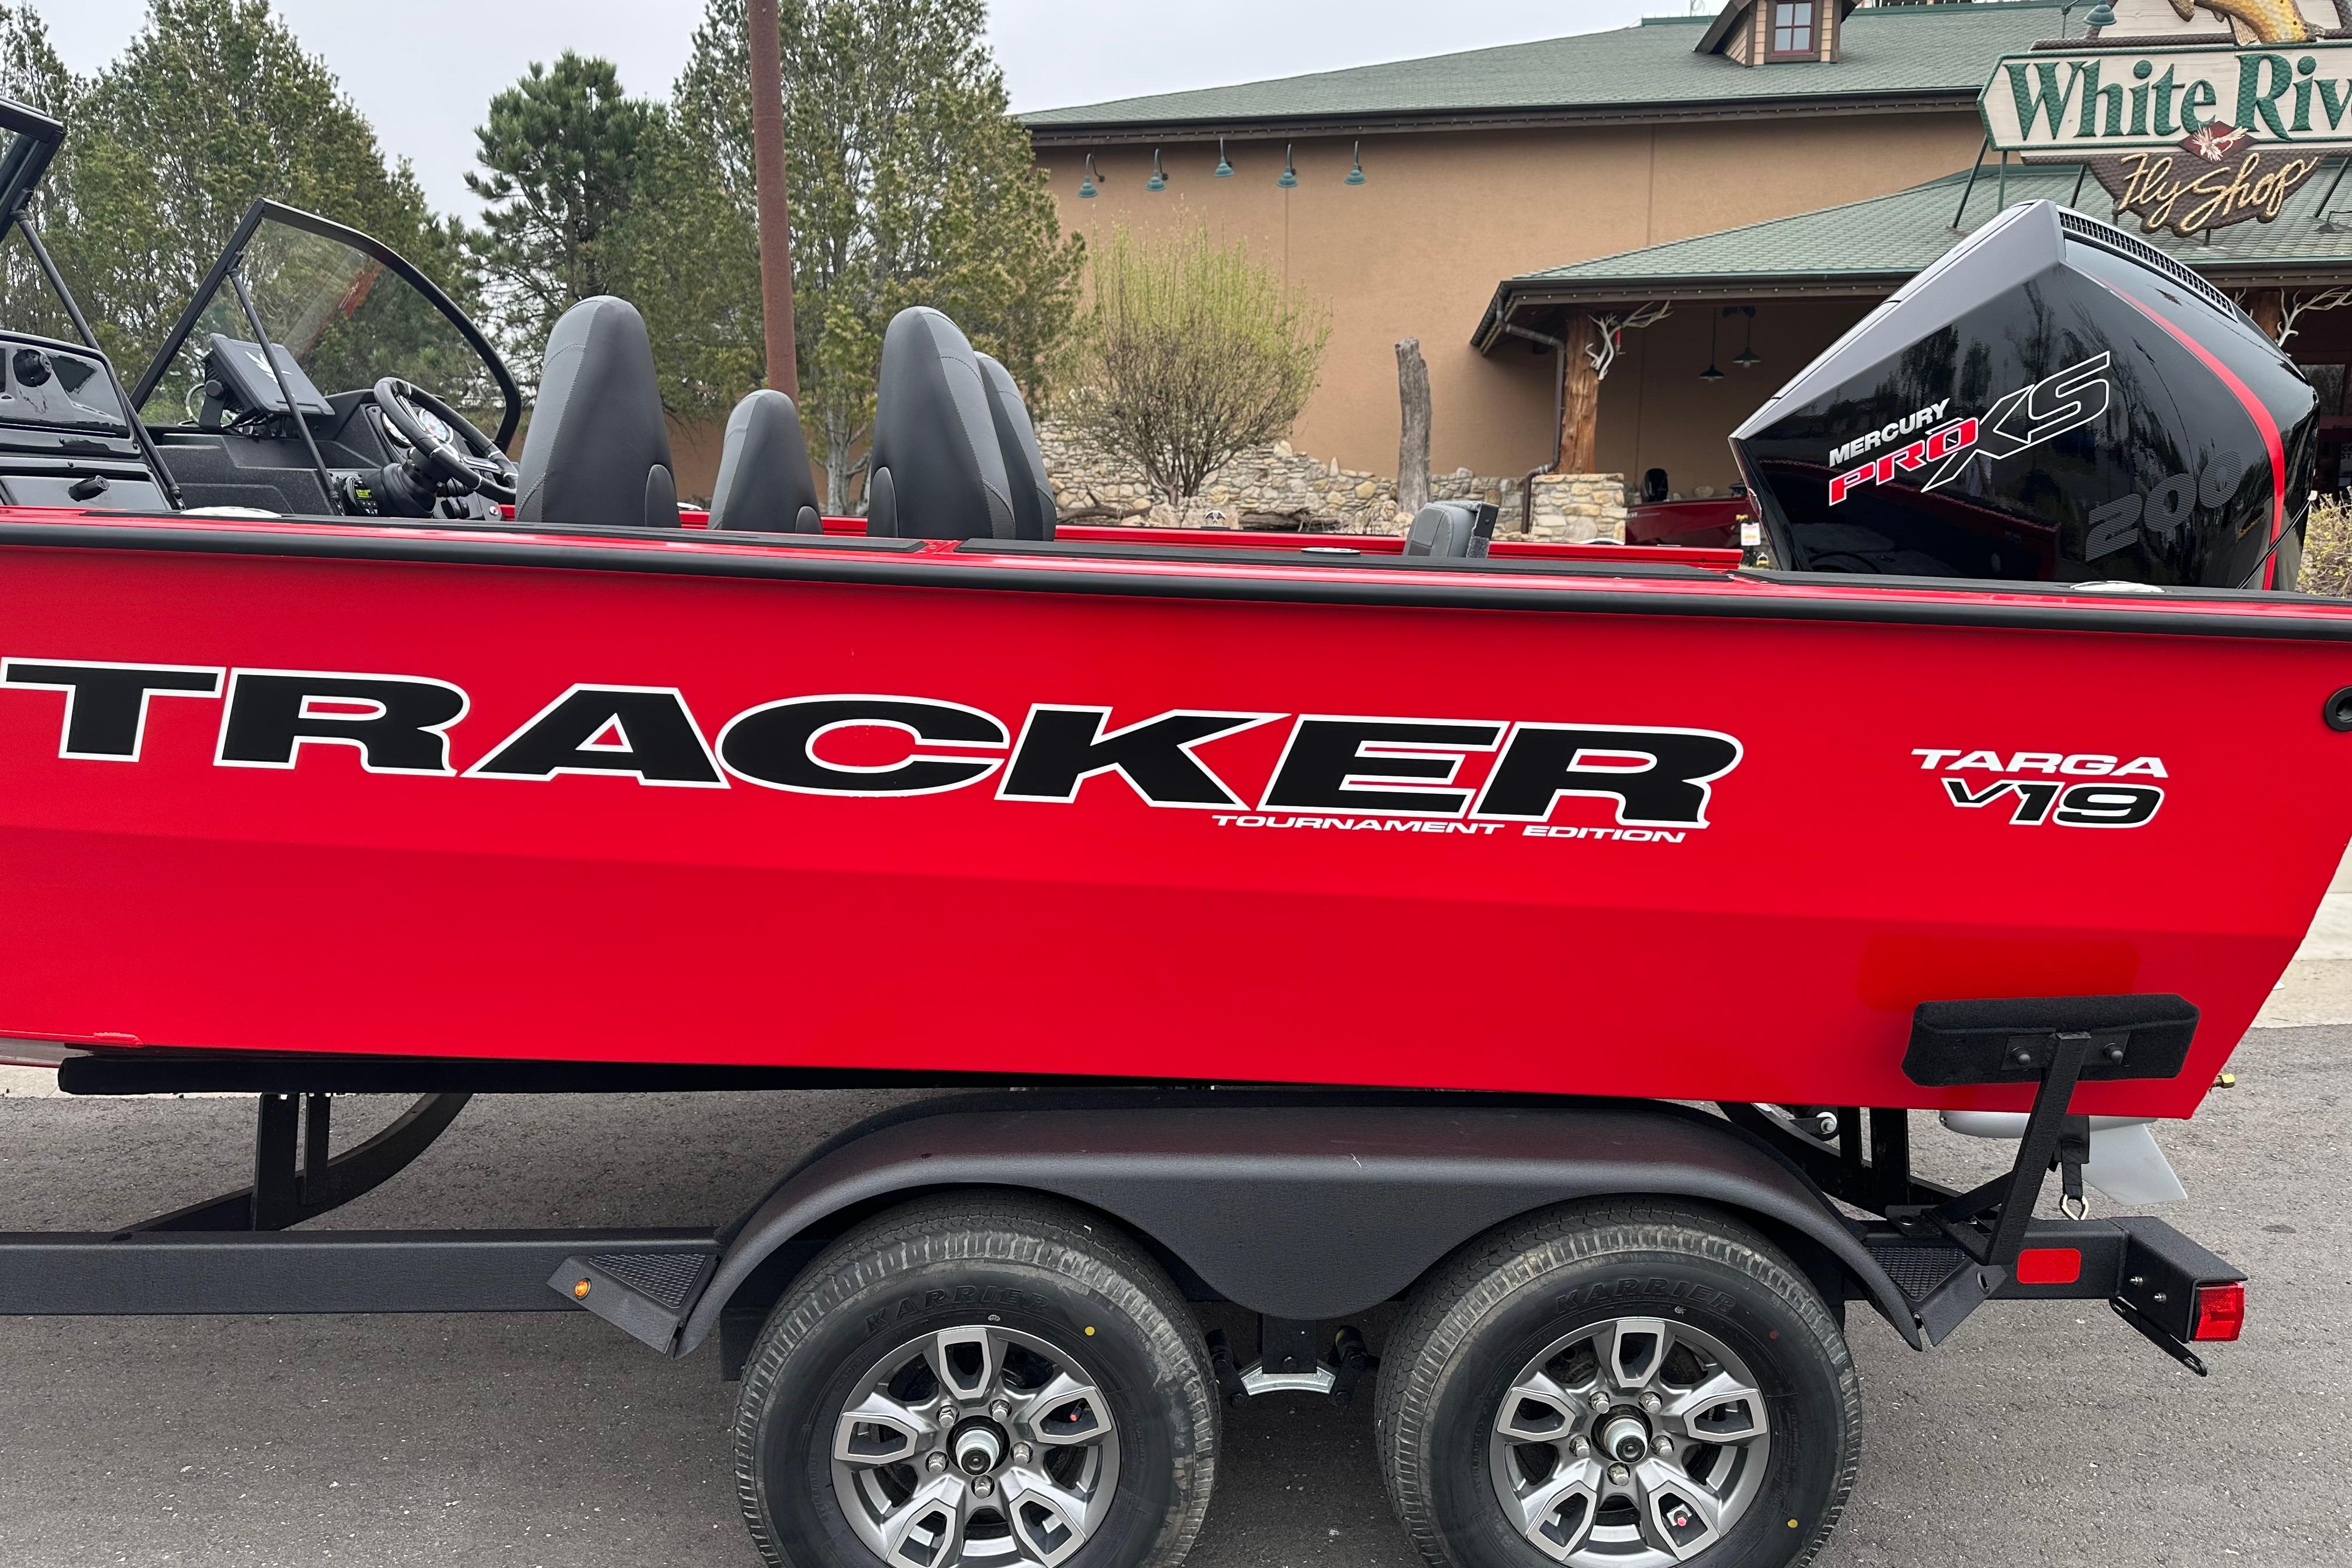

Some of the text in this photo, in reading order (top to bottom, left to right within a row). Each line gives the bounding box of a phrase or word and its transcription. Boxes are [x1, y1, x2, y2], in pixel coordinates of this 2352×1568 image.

[2003, 53, 2352, 141] White Riv
[2120, 152, 2318, 232] Fly Shop
[1828, 416, 1980, 506] PRO
[1829, 398, 1951, 468] MERCURY
[2084, 449, 2241, 562] 200
[0, 657, 1744, 830] TRACKER
[1912, 748, 2168, 778] TARGA
[1212, 814, 1686, 844] TOURNAMENT EDITION
[1941, 778, 2165, 828] V19
[864, 1285, 1049, 1332] KARRIER
[1556, 1278, 1737, 1313] KARRIER
